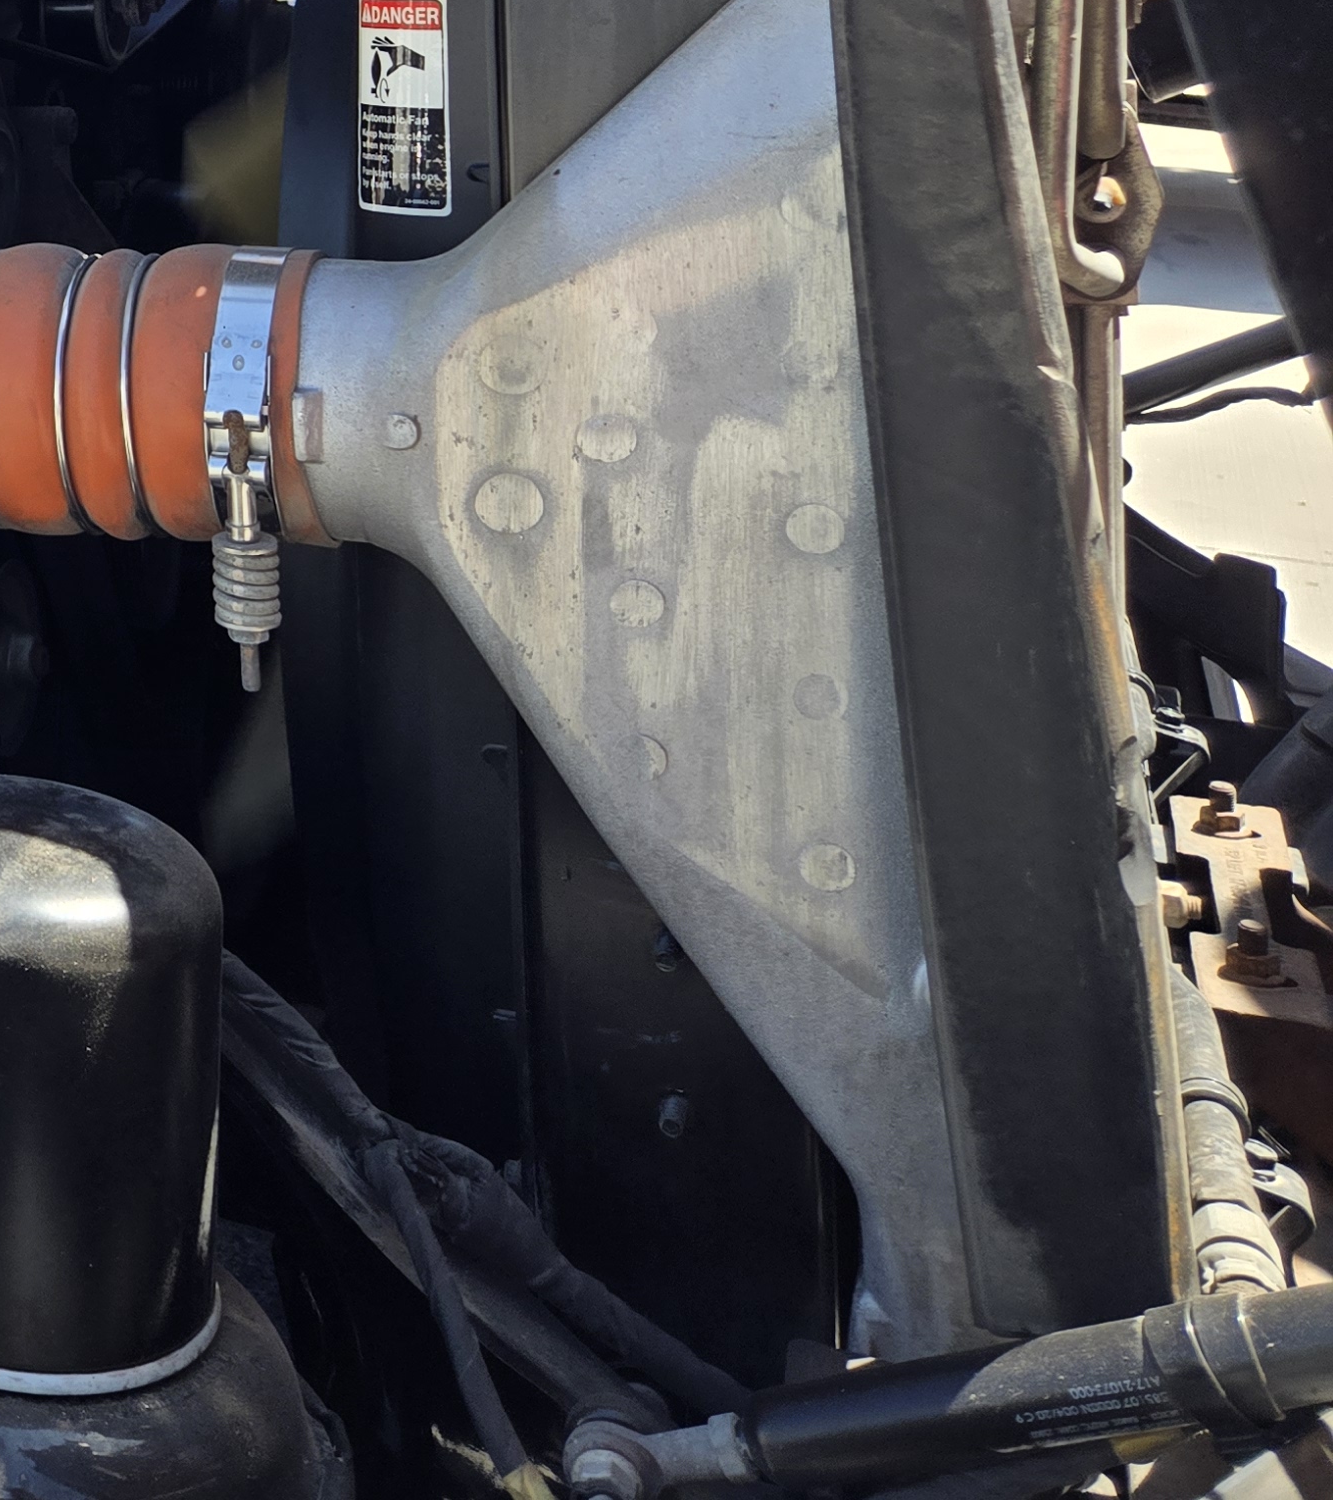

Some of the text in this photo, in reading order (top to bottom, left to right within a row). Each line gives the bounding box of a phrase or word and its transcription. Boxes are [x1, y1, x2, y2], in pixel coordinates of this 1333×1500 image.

[372, 6, 439, 25] DANGER
[363, 111, 429, 126] Automatic Fan
[379, 130, 405, 141] hands
[406, 130, 432, 142] clear
